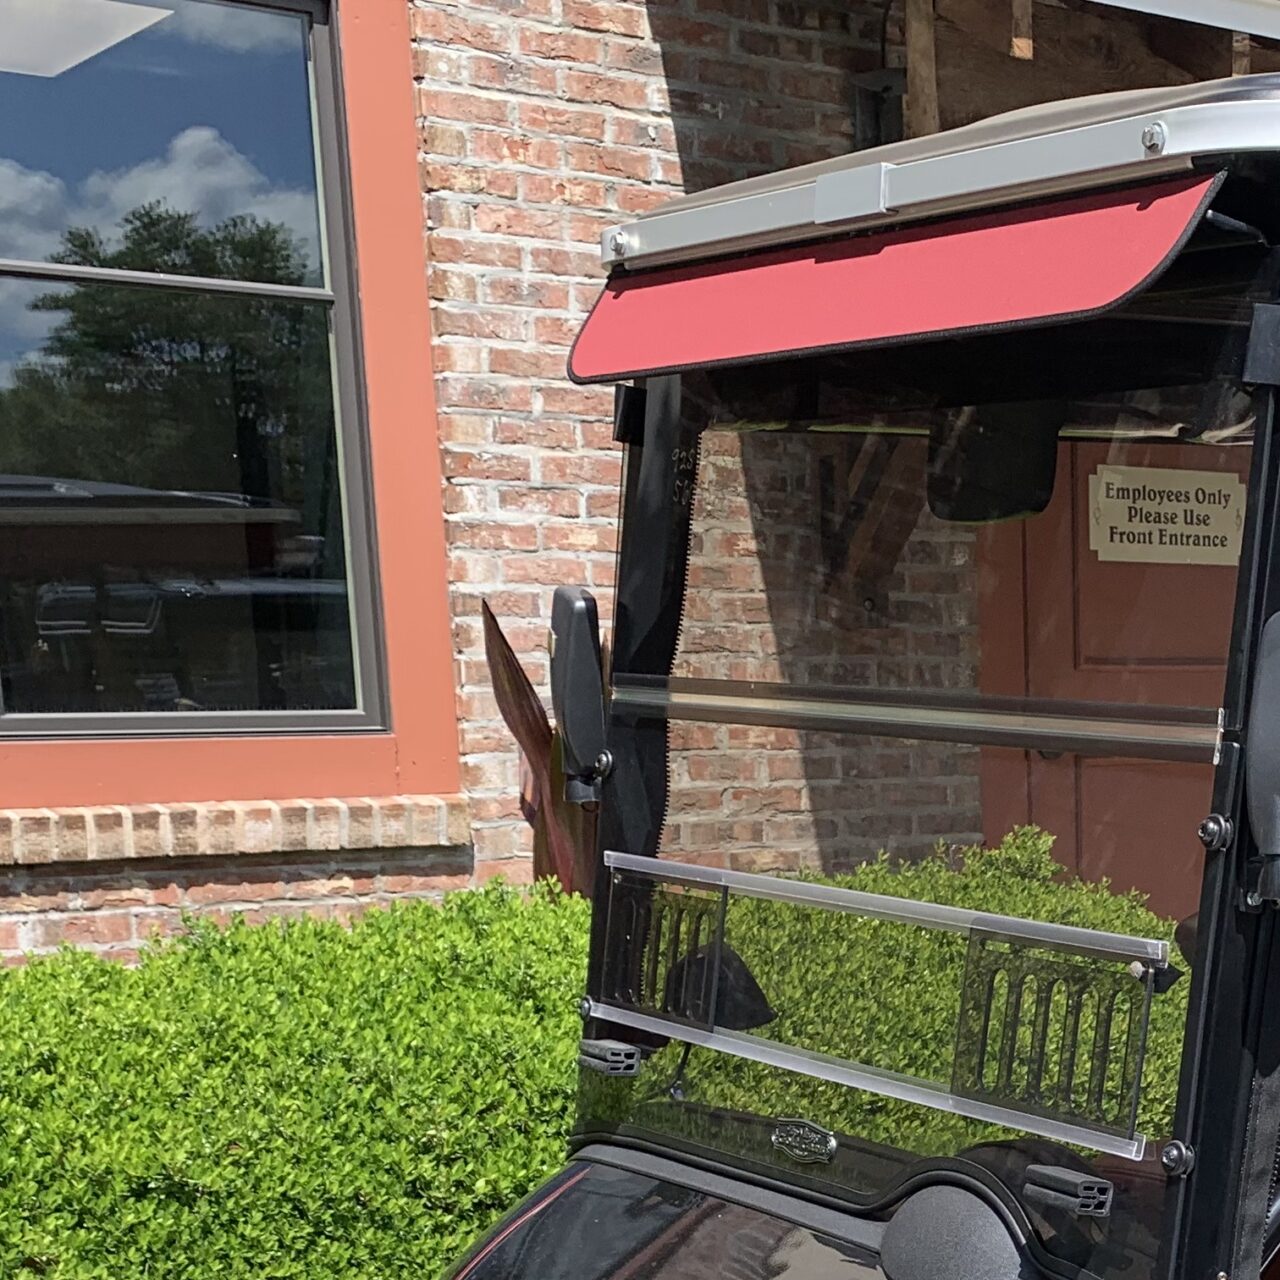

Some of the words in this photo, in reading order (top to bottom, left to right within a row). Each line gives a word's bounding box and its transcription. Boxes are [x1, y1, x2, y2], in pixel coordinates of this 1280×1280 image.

[1105, 482, 1190, 506] Employees
[1195, 487, 1231, 509] Only
[1127, 506, 1178, 525] Please
[1183, 509, 1210, 526] Use
[1109, 526, 1153, 545] Front
[1158, 529, 1228, 547] Entrance
